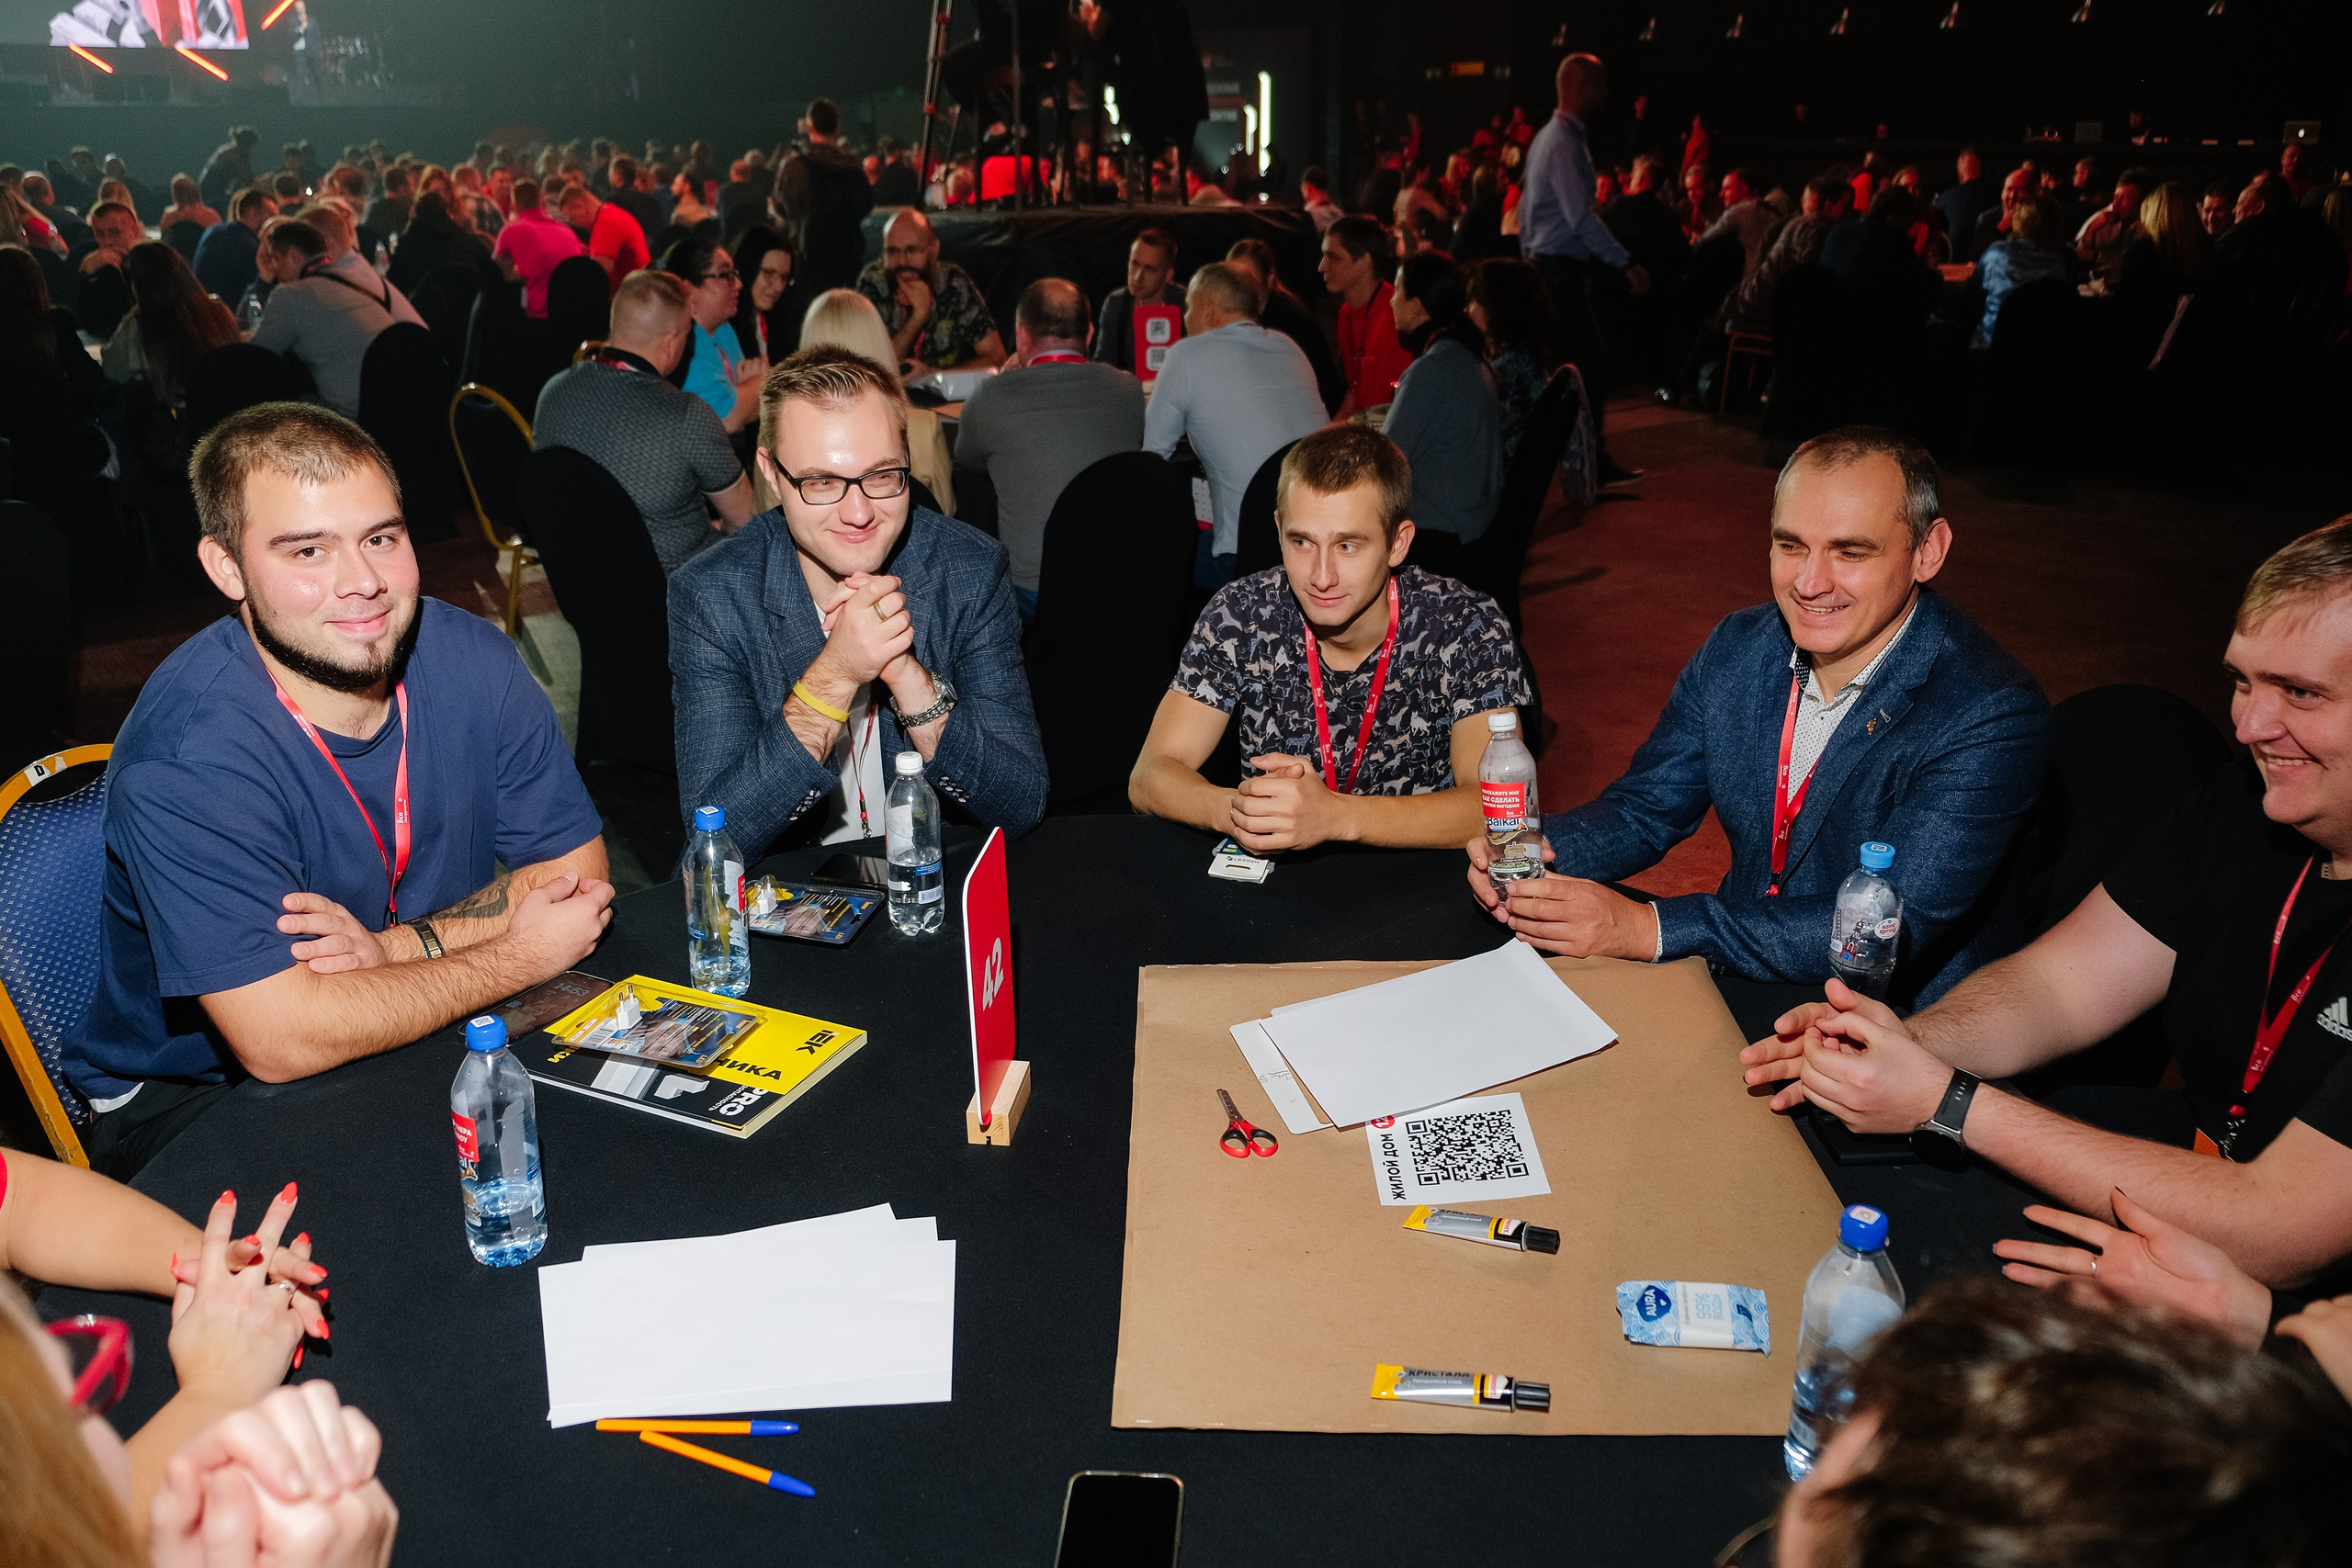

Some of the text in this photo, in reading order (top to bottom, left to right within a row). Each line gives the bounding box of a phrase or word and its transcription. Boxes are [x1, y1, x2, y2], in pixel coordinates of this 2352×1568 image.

[982, 937, 1005, 1012] 42
[718, 1086, 769, 1116] PRO
[1379, 1134, 1407, 1201] ЖИЛОЙ ДОМ
[1644, 1289, 1657, 1317] AURA
